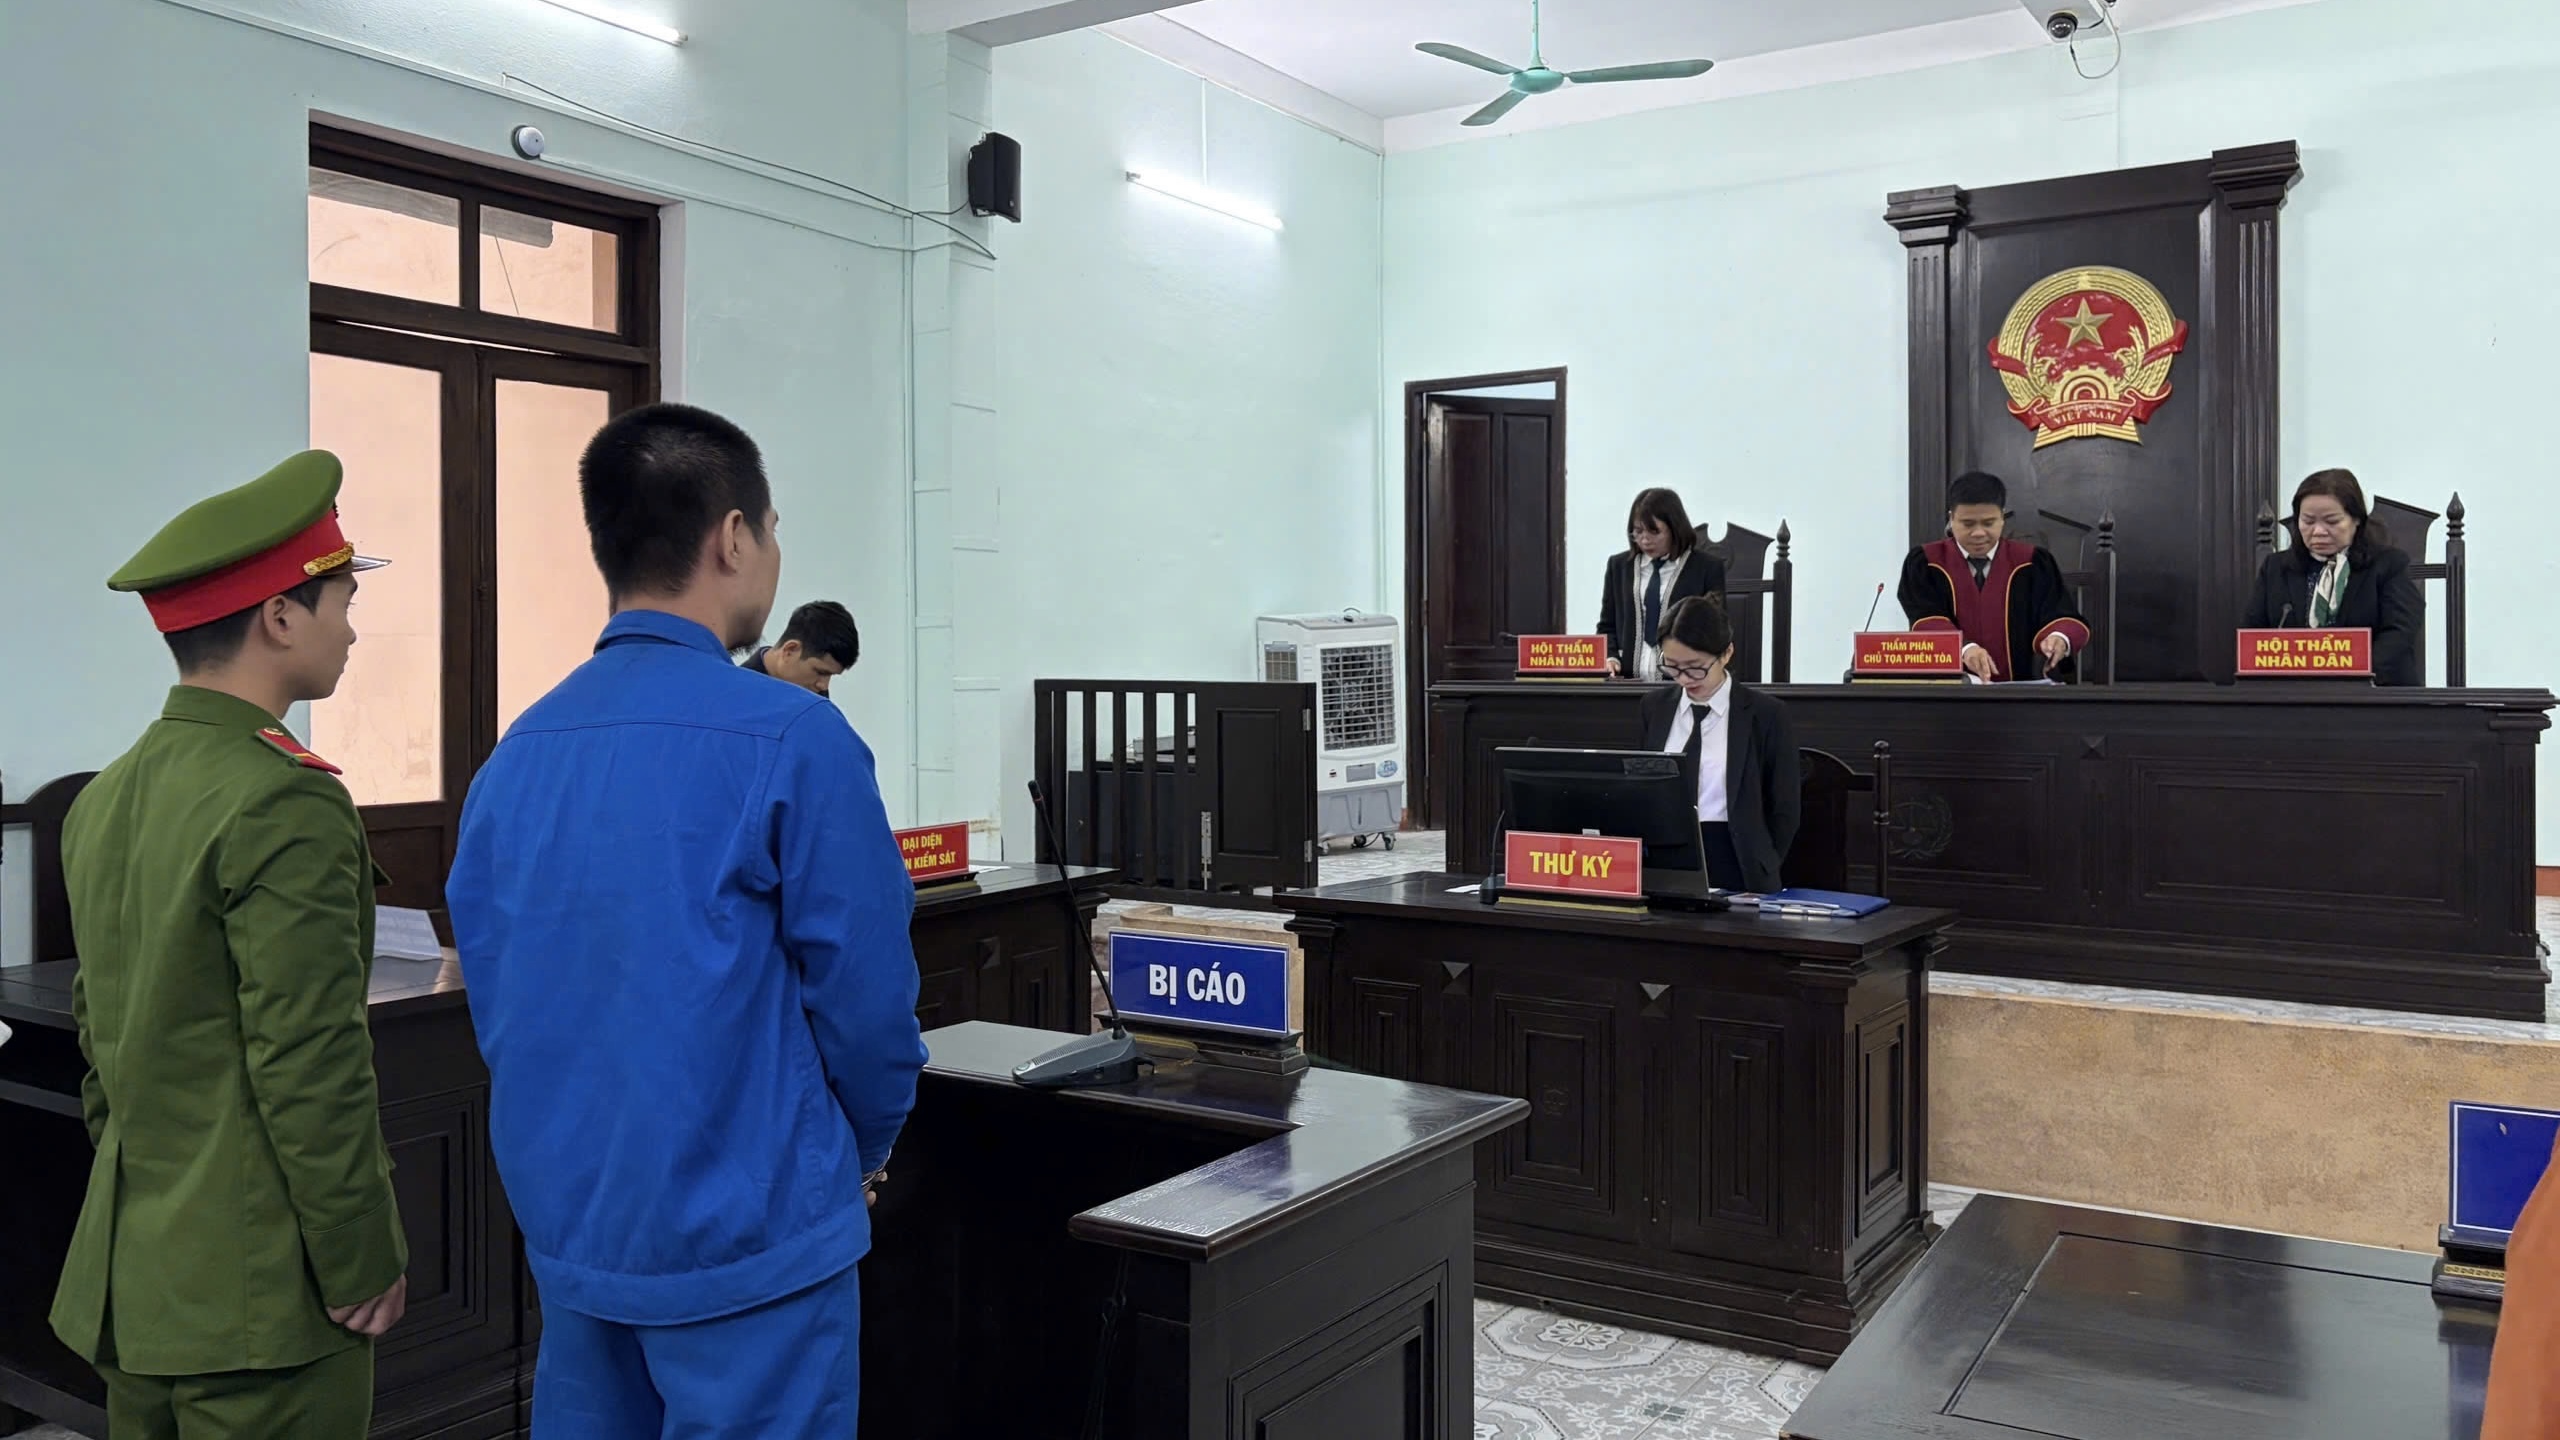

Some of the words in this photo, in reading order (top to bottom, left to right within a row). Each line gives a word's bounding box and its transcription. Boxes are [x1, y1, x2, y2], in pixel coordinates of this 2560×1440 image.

[2088, 408, 2116, 421] NAM
[1531, 641, 1553, 655] HỘI
[1556, 639, 1593, 654] THẨM
[1881, 637, 1907, 651] THẨM
[1909, 640, 1934, 651] PHÁN
[2256, 636, 2289, 653] HỘI
[2295, 634, 2350, 652] THẨM
[1530, 655, 1564, 666] NHÂN
[1568, 656, 1595, 666] DÂN
[1863, 651, 1882, 663] CHỦ
[1884, 654, 1902, 665] TỌA
[1904, 652, 1932, 663] PHIÊN
[1934, 653, 1952, 663] TÒA
[2255, 653, 2306, 667] NHÂN
[2313, 653, 2353, 668] DÂN
[902, 838, 919, 852] ĐẠI
[921, 833, 942, 849] DIỆN
[914, 851, 937, 869] KIỂM
[939, 850, 956, 865] SÁT
[1529, 850, 1576, 876] THƯ
[1581, 850, 1613, 878] KÝ
[1149, 963, 1177, 1006] BỊ
[1187, 961, 1246, 1006] CÁO
